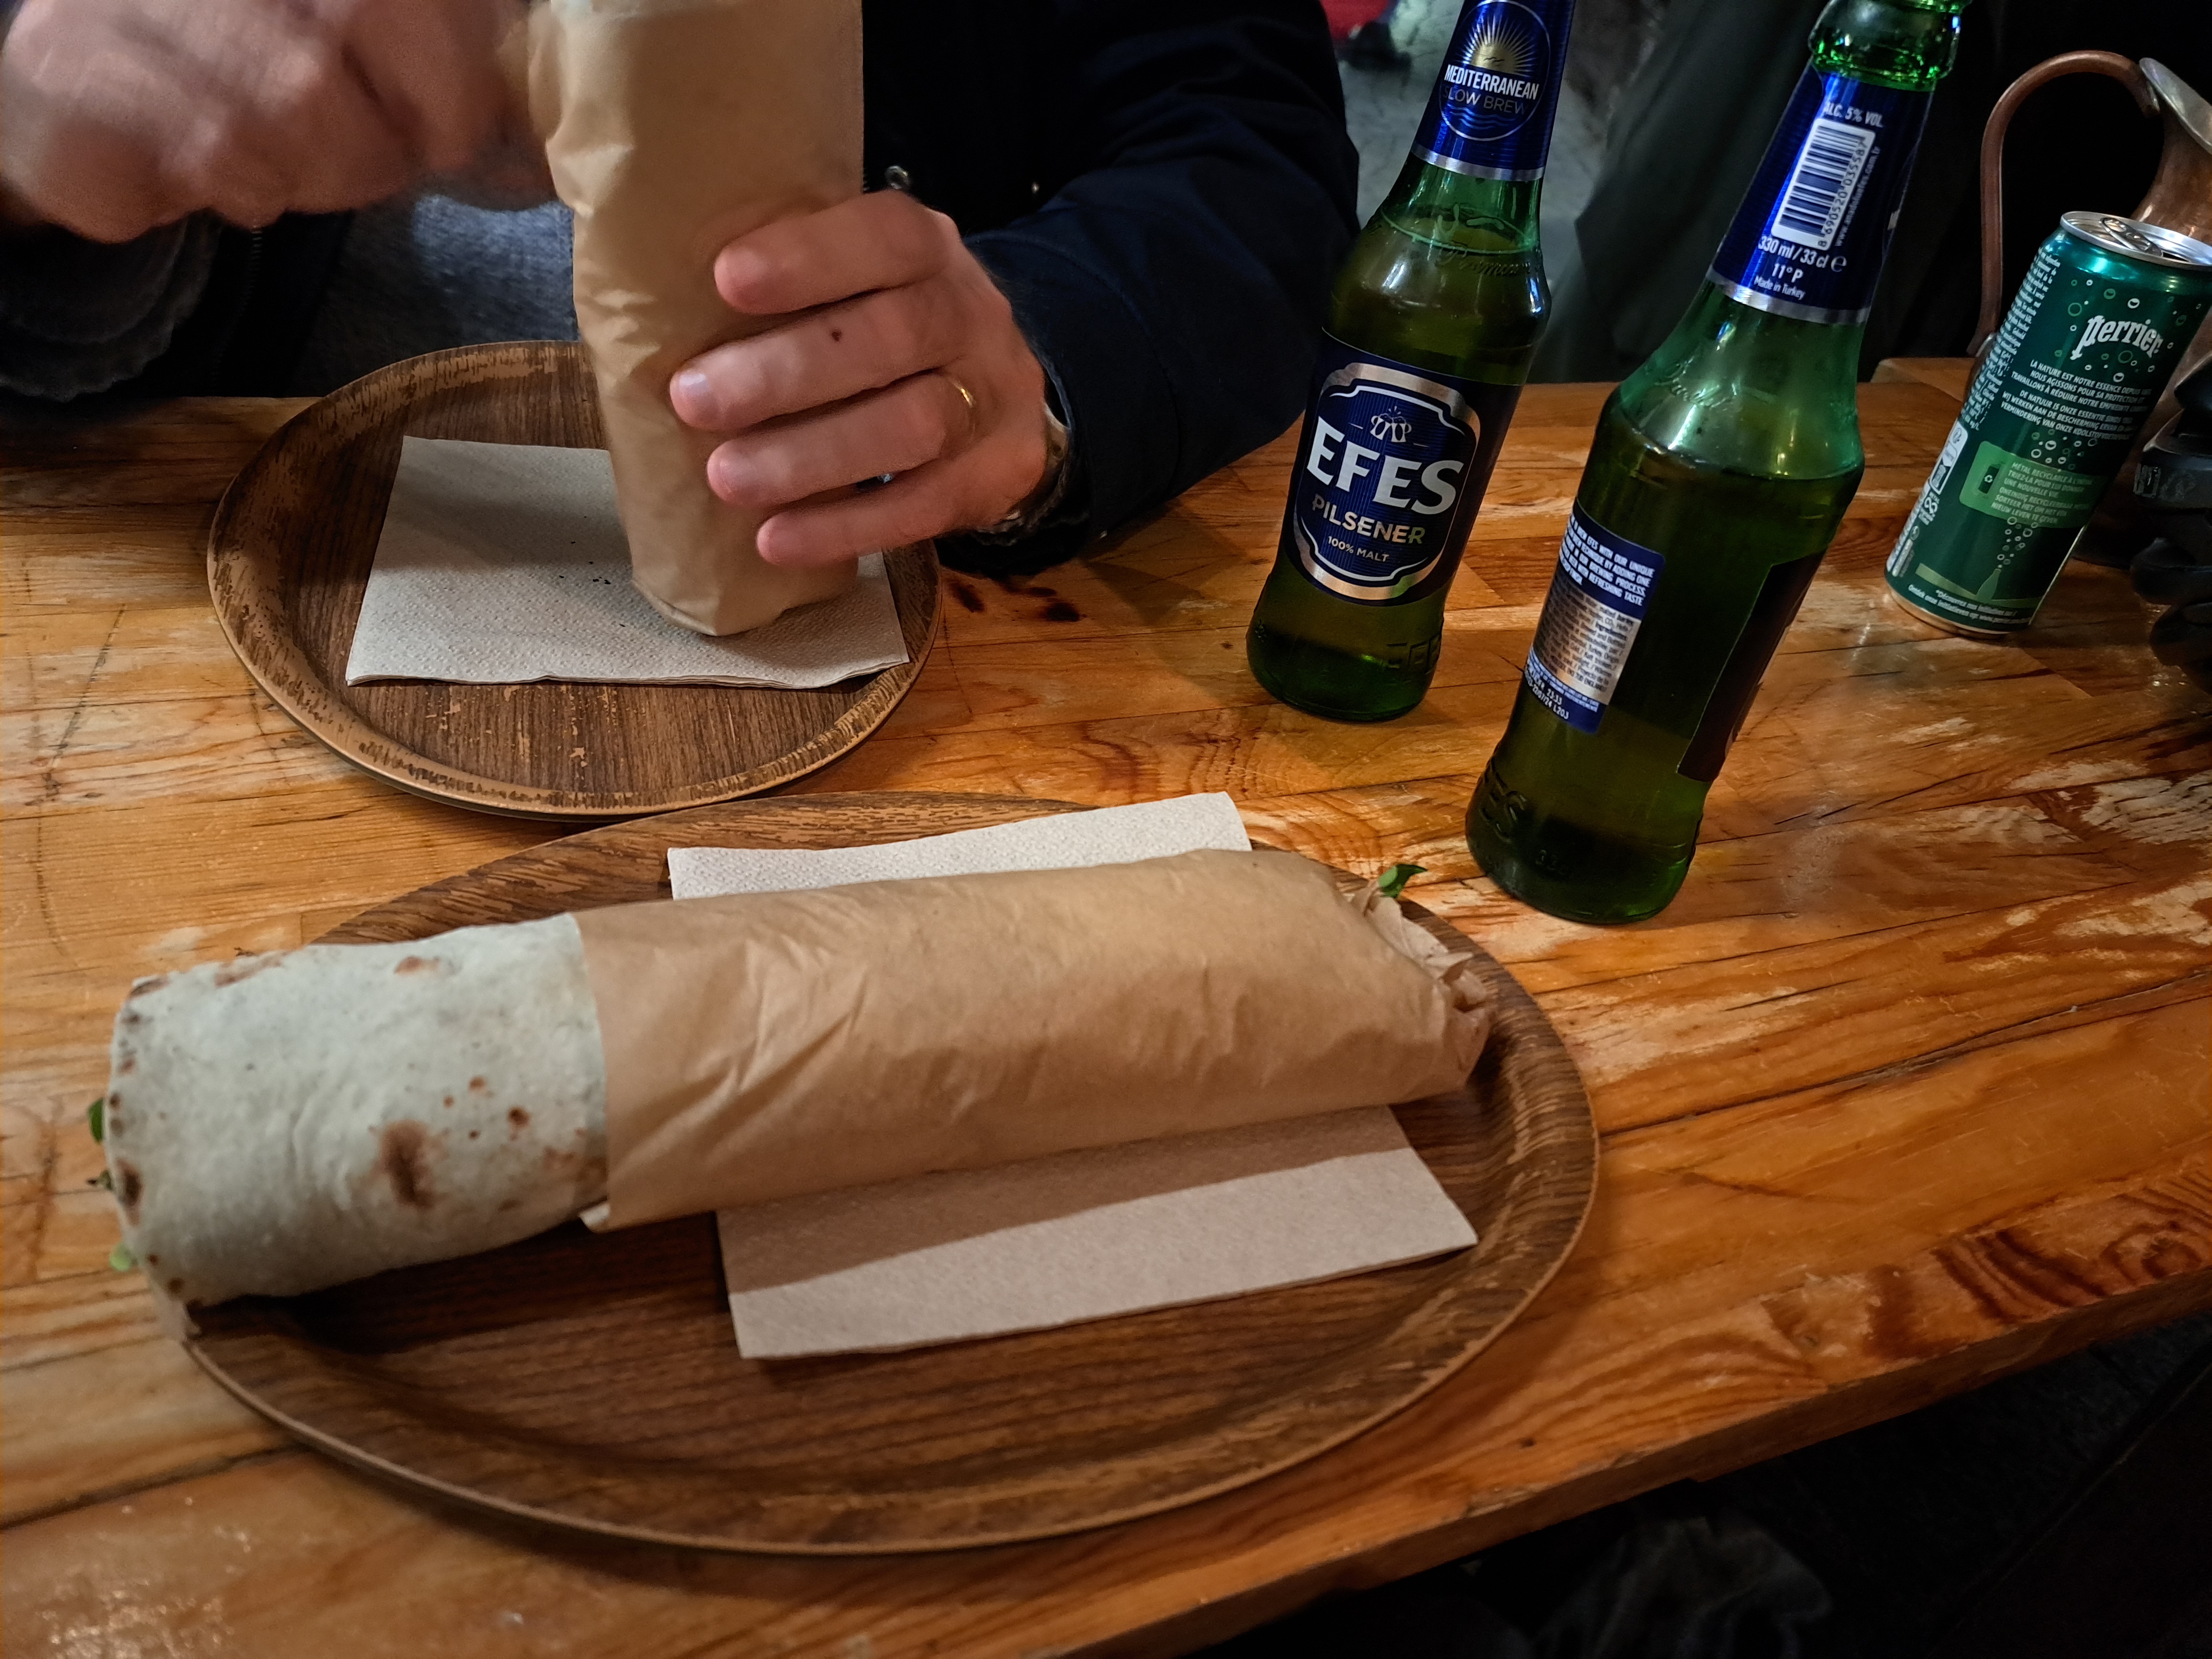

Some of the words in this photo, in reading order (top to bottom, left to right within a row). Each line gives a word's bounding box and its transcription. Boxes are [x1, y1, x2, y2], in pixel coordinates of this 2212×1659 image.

[1444, 64, 1539, 100] MEDITERRANEAN
[1444, 87, 1482, 106] SLOW
[1483, 96, 1528, 115] BREW
[1845, 106, 1864, 122] 5%
[1758, 235, 1780, 254] 330
[1778, 243, 1796, 259] ml
[1800, 248, 1817, 265] 33
[1816, 254, 1830, 268] cl
[1753, 275, 1774, 290] Made
[1773, 281, 1782, 292] in
[1782, 283, 1806, 300] Turkey
[2011, 371, 2045, 392] TRAVAILLONS
[2044, 385, 2050, 394] À
[2050, 388, 2079, 402] RÉDUIRE
[2077, 397, 2100, 408] NOTRE
[2030, 359, 2038, 368] LA
[2037, 363, 2062, 377] NATURE
[2061, 372, 2074, 381] EST
[2073, 376, 2096, 387] NOTRE
[2095, 382, 2122, 393] ESSENCE
[2030, 370, 2047, 381] NOUS
[2046, 377, 2078, 392] AGISSONS
[2077, 387, 2096, 397] POUR
[2002, 391, 2012, 402] WIJ
[2011, 395, 2034, 410] WERKEN
[2033, 406, 2048, 416] AAN
[2047, 410, 2057, 419] DE
[2057, 414, 2101, 431] BESCHERMING
[2019, 389, 2028, 398] DE
[2027, 393, 2053, 408] NATUUR
[2059, 405, 2078, 415] ONZE
[2001, 400, 2042, 425] VERMINDERING
[2042, 419, 2056, 428] VAN
[2055, 423, 2073, 433] ONZE
[1306, 415, 1464, 515] EFES
[2004, 477, 2017, 487] UNE
[1312, 493, 1426, 544] PILSENER
[1328, 536, 1354, 554] 100%
[1357, 547, 1390, 562] MALT
[1615, 576, 1646, 597] PROCESS
[1624, 591, 1644, 606] TASTE
